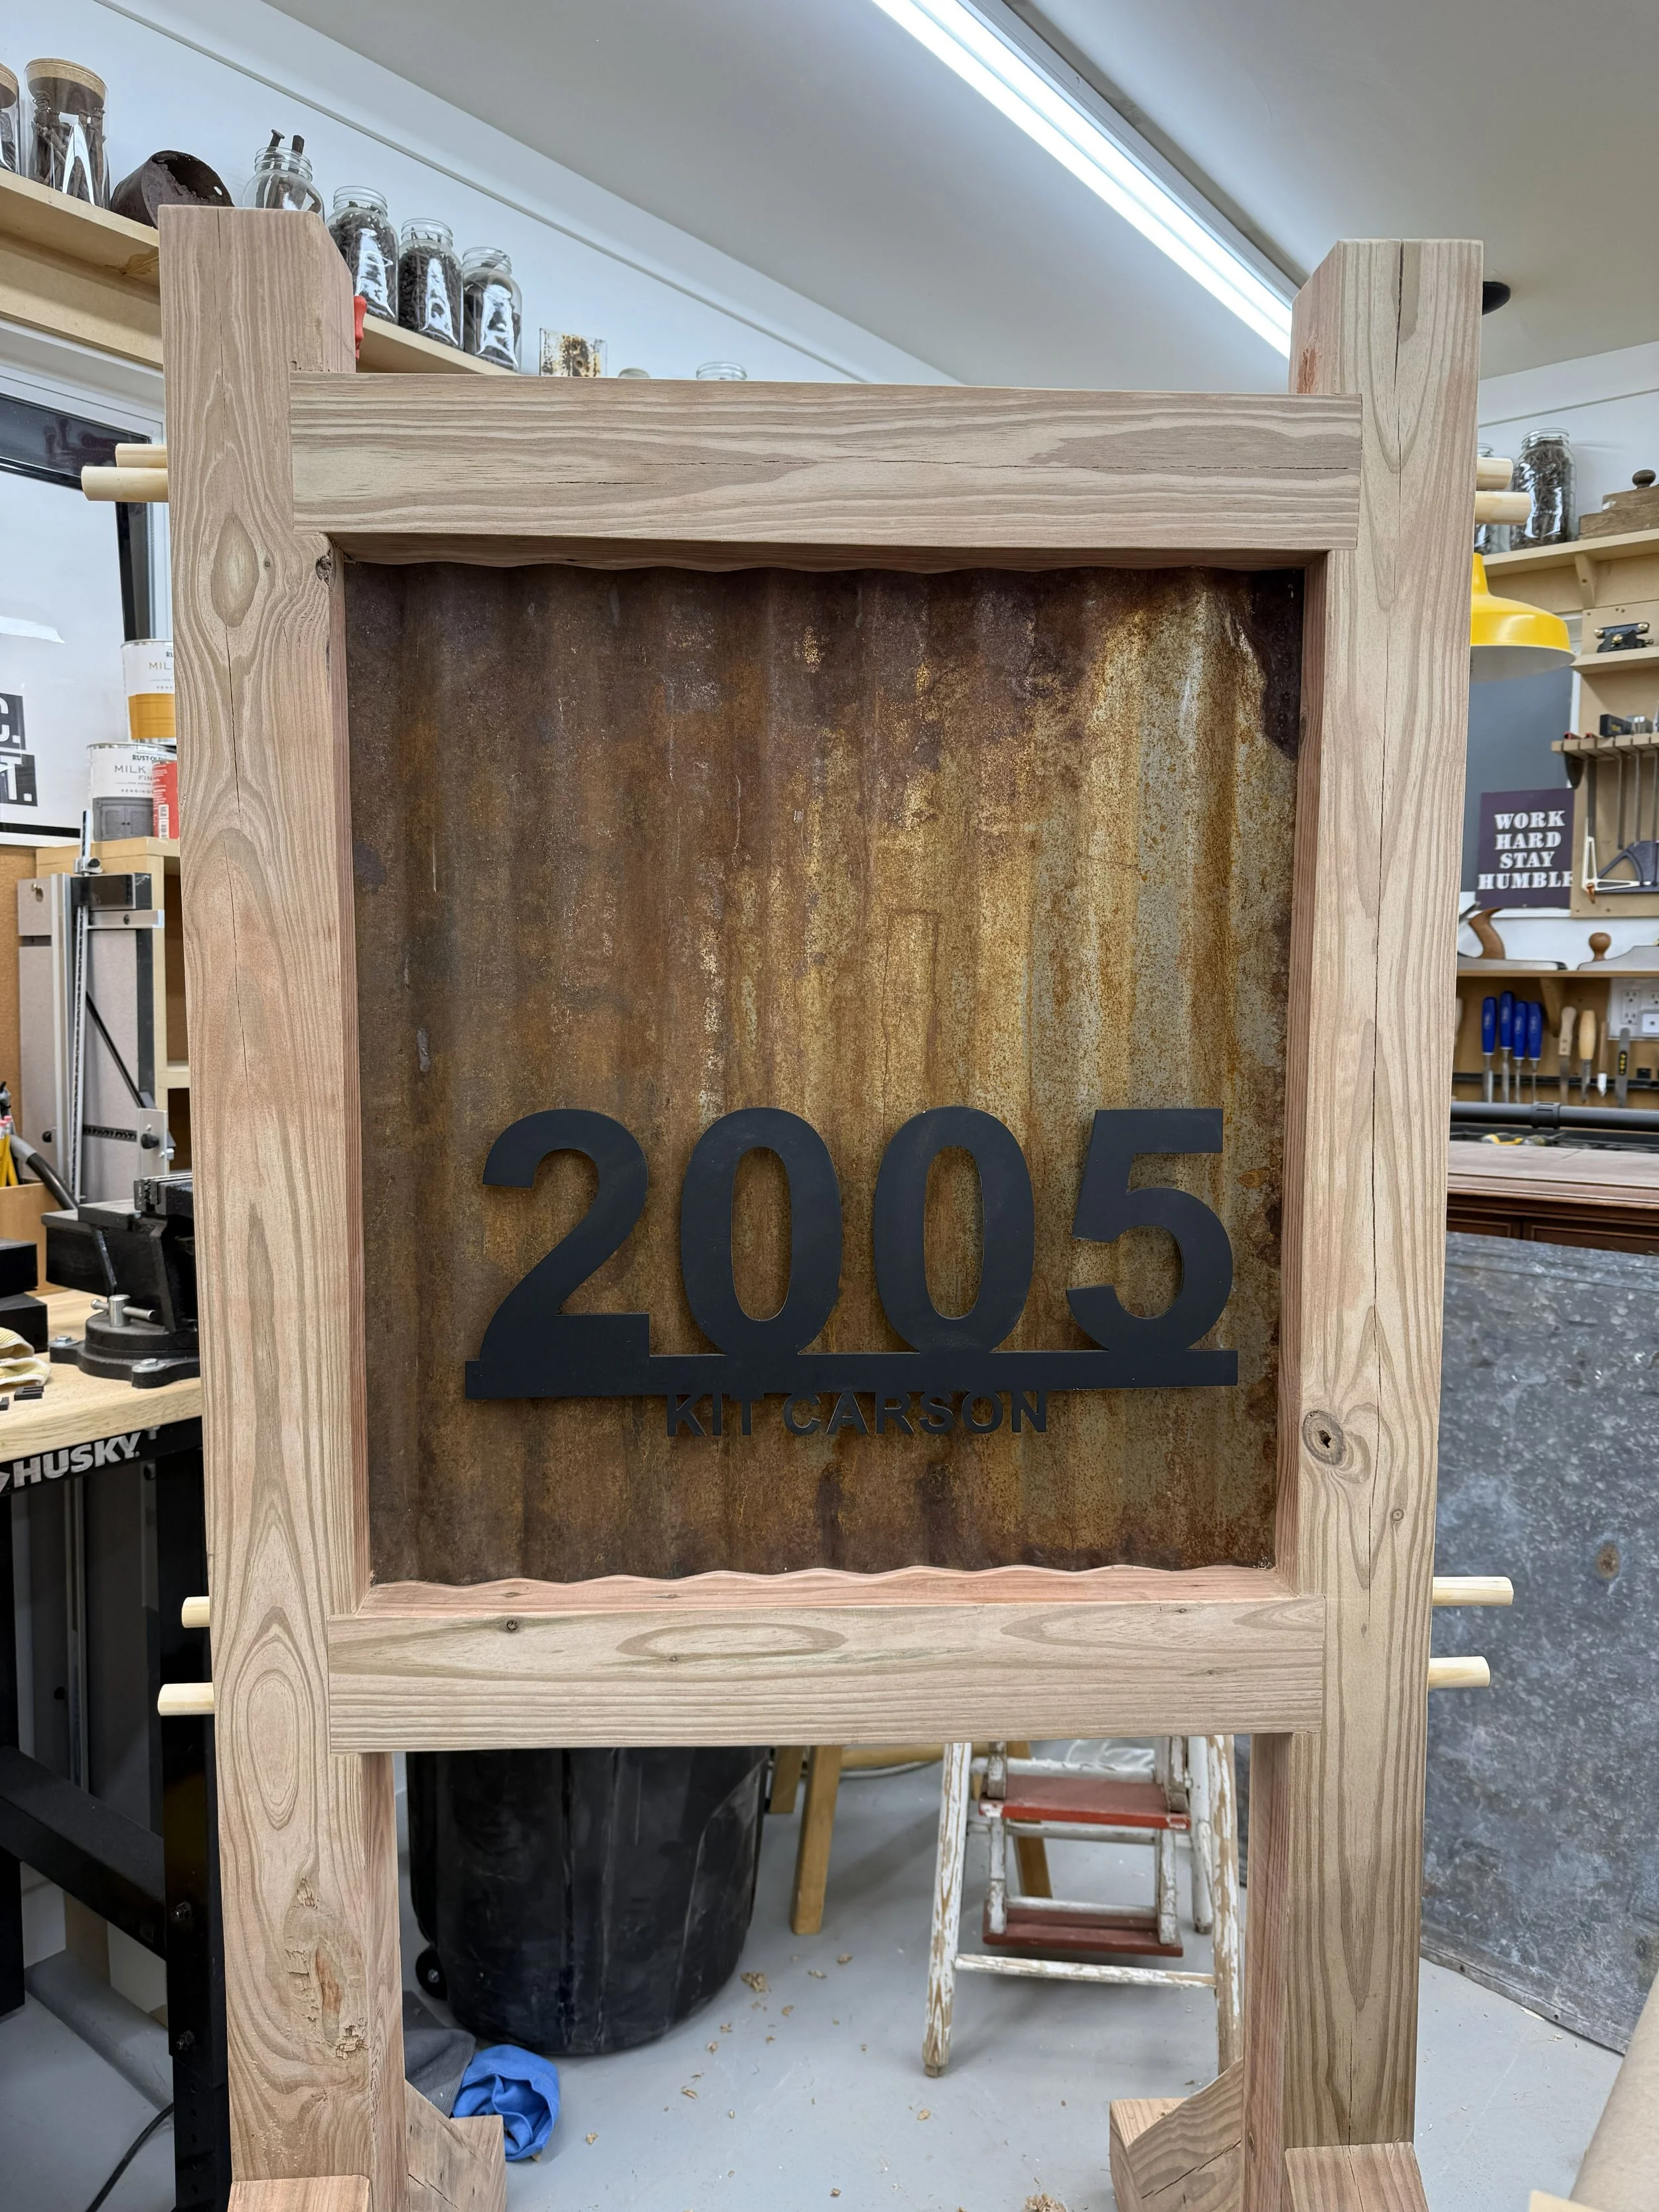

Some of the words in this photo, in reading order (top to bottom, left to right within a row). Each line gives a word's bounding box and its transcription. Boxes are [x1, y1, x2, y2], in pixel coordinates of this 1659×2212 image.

[114, 765, 147, 774] MILK
[1494, 810, 1565, 830] WORK
[1494, 831, 1561, 850] HARD
[1499, 851, 1555, 869] STAY
[1477, 871, 1573, 890] HUMBLE
[478, 1106, 1234, 1367] 2005
[666, 1392, 764, 1437] KIT
[783, 1389, 1048, 1436] CARSON
[13, 1432, 141, 1489] HUSKY
